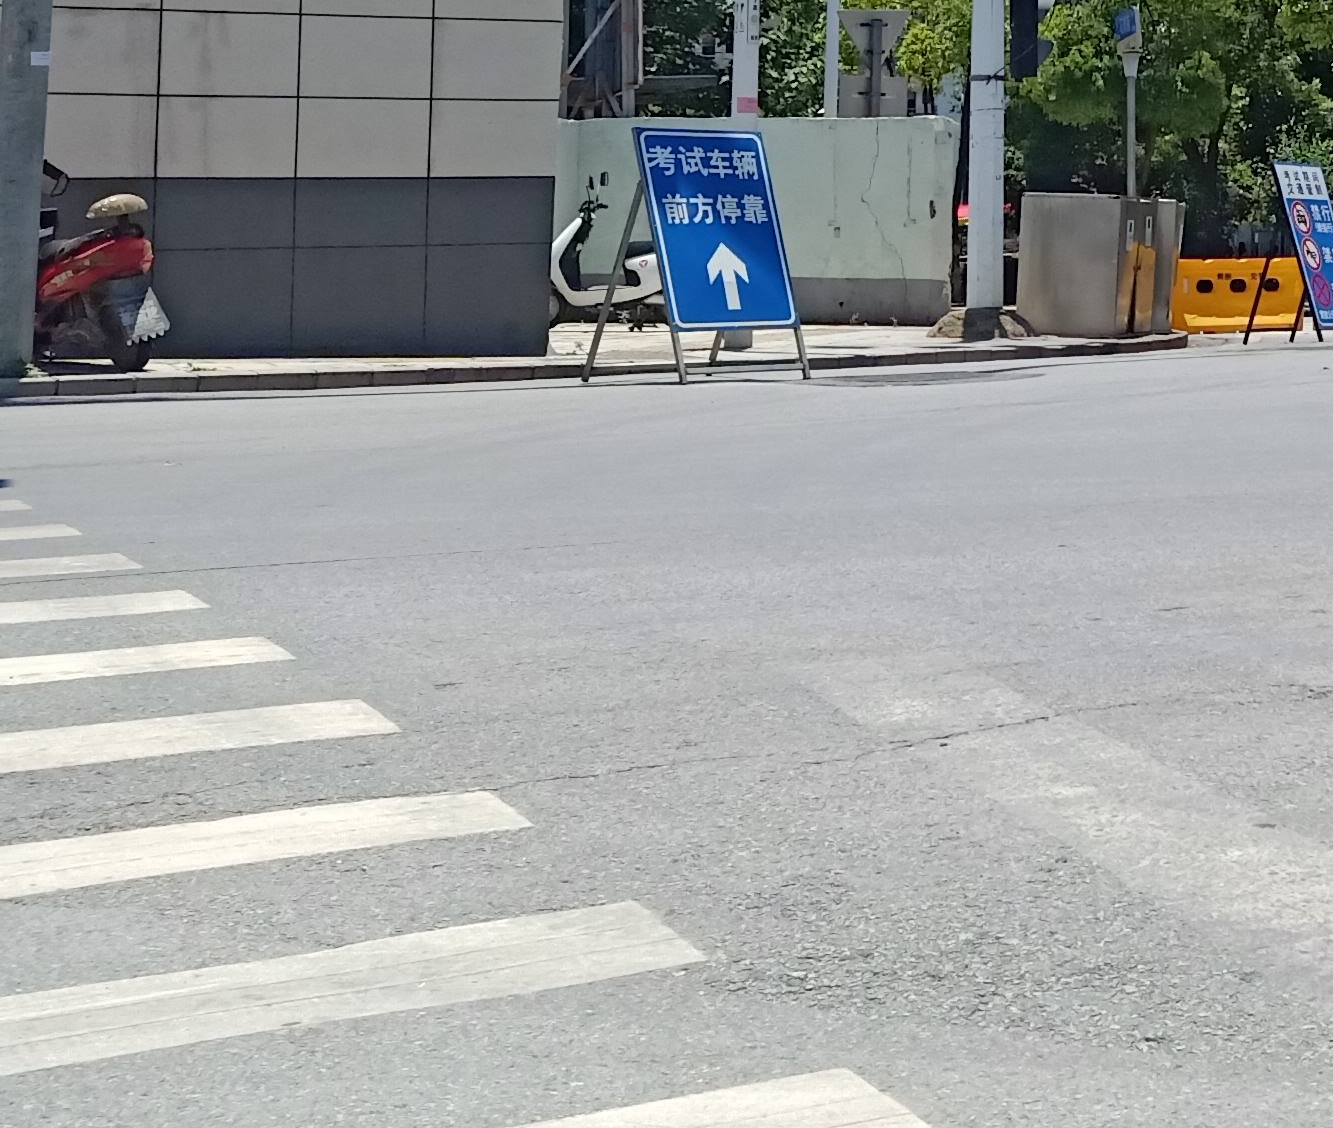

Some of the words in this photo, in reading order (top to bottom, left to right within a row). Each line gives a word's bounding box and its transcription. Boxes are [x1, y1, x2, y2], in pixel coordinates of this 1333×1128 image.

[648, 145, 759, 181] 考试车辆
[662, 193, 769, 225] 前方停靠
